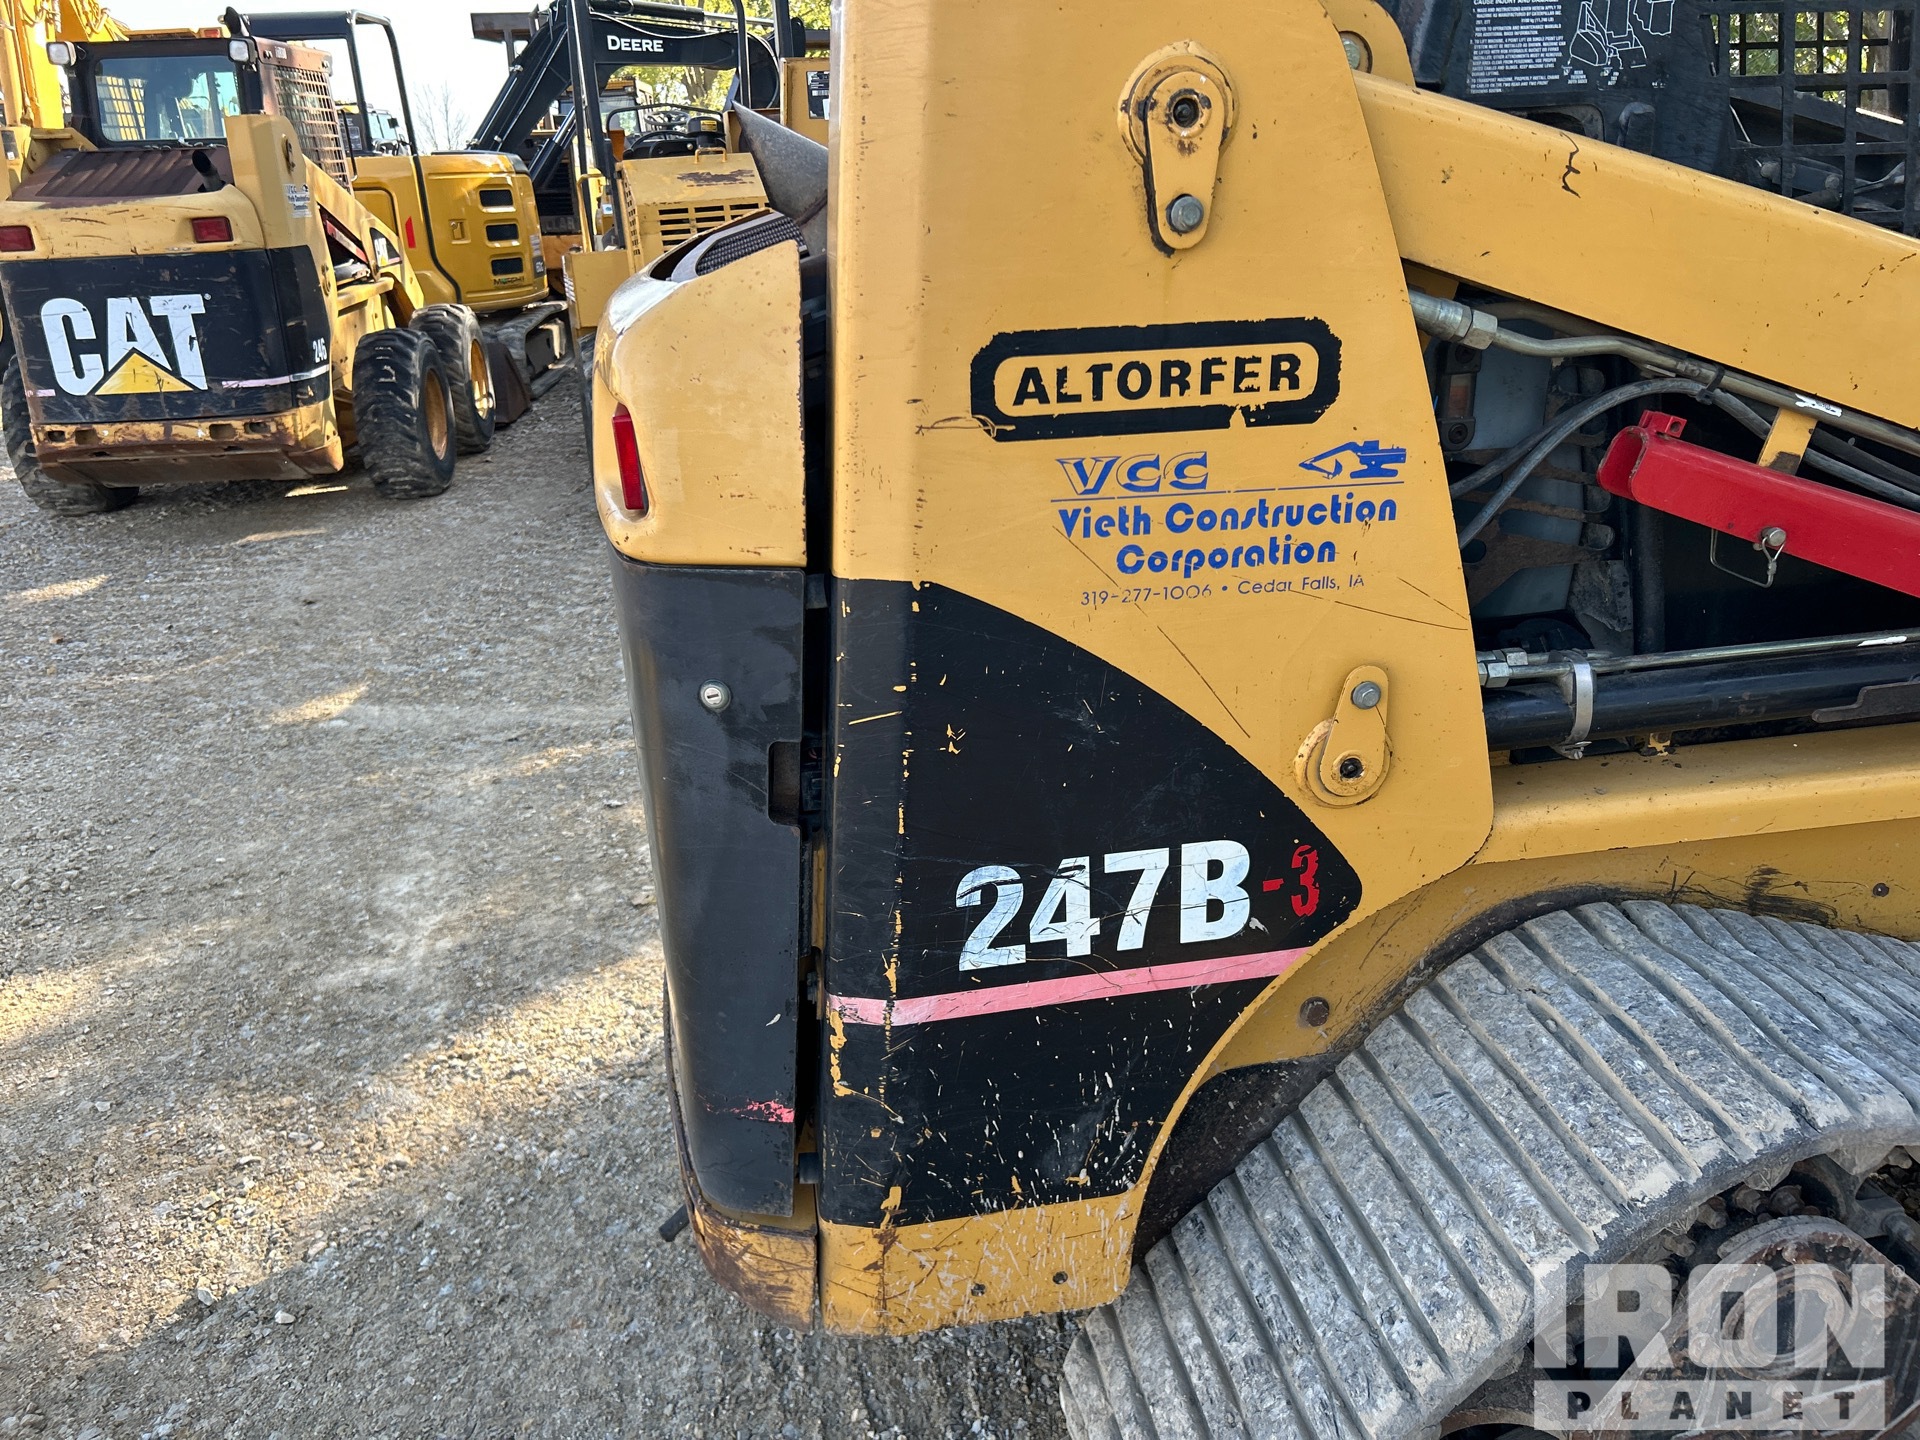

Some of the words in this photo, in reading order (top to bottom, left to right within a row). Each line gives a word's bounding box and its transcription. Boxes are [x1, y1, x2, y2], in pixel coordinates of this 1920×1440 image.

[607, 35, 664, 52] DEERE
[41, 293, 208, 396] CAT
[1011, 353, 1302, 407] ALTORFER
[1055, 450, 1209, 495] VCC
[1058, 505, 1151, 539] Vieth
[1165, 492, 1397, 534] Construction
[1116, 534, 1336, 579] Corporation
[1080, 584, 1213, 606] 319-277-1006
[1237, 579, 1293, 595] Cedar
[1301, 576, 1340, 591] Falls,
[1349, 574, 1365, 588] IA
